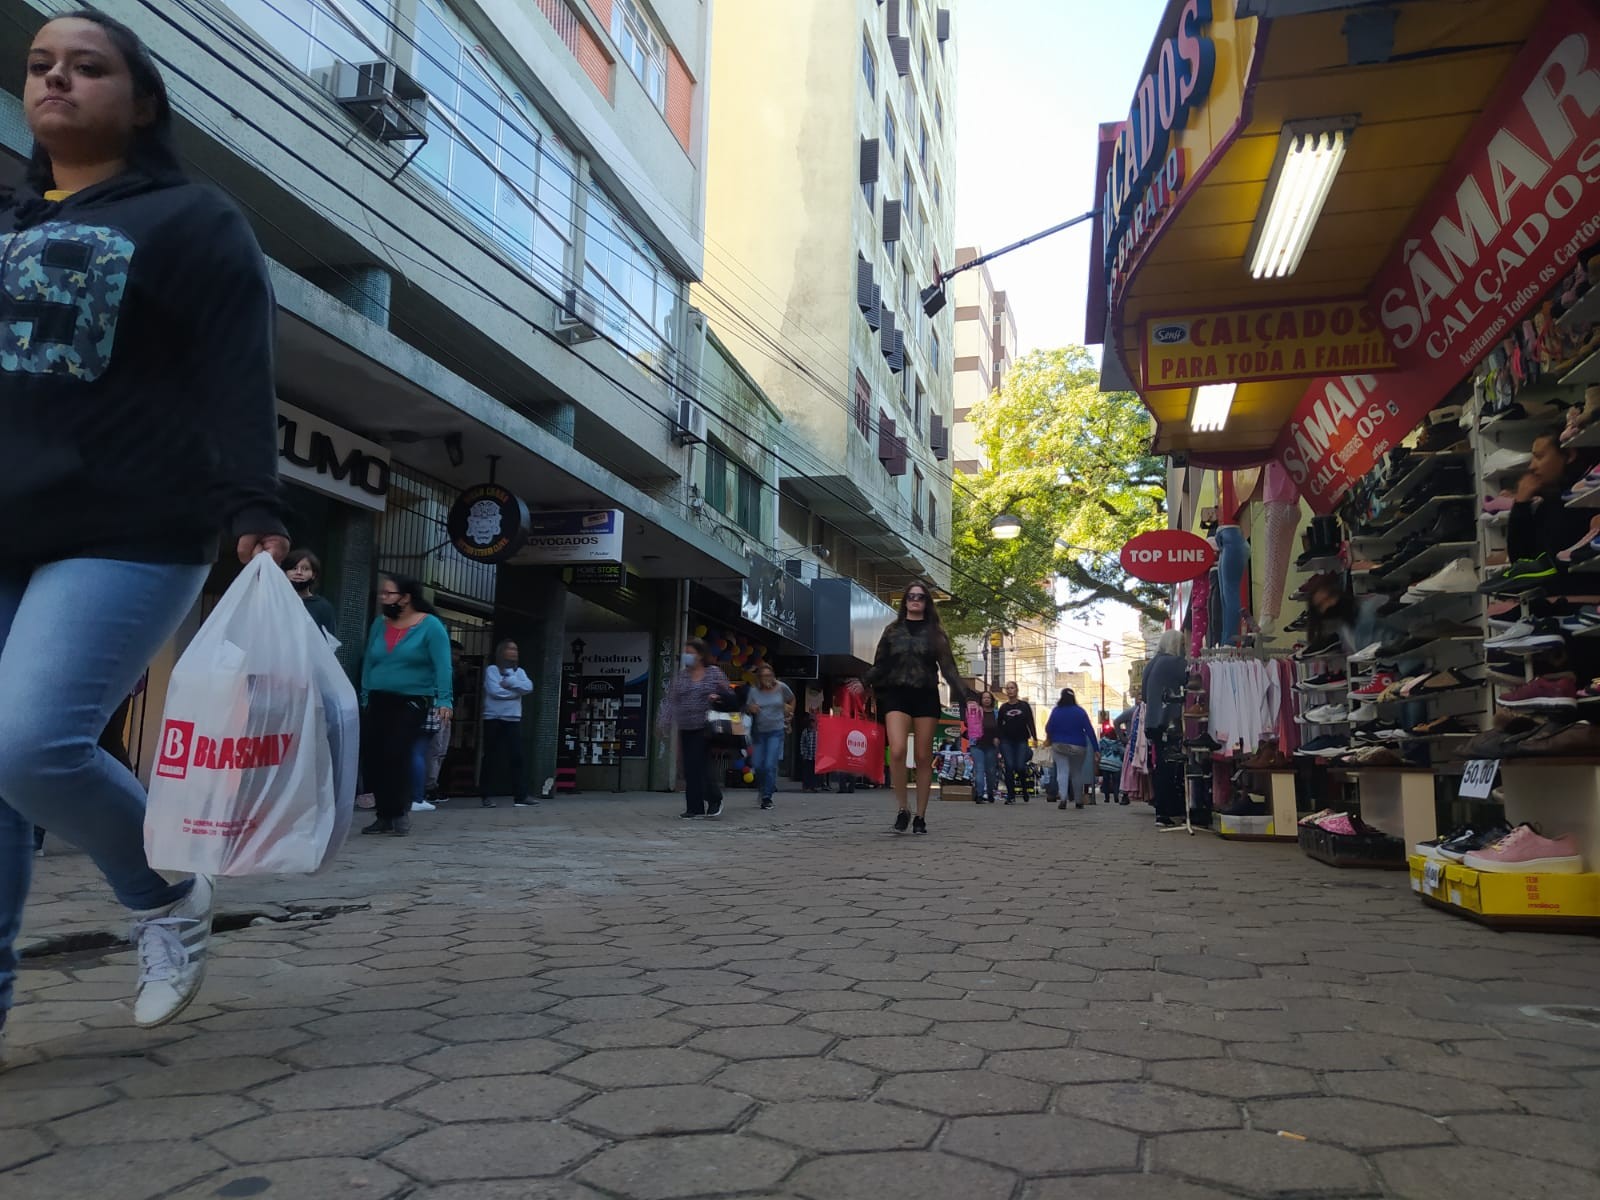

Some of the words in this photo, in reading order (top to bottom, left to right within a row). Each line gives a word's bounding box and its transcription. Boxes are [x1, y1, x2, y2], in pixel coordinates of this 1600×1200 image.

[1459, 315, 1507, 367] Aceitamos
[1502, 279, 1540, 318] Todos
[1538, 263, 1556, 284] os
[1553, 210, 1600, 266] Cartõe
[1190, 307, 1377, 349] CALÇADOS
[1161, 354, 1218, 380] PARA
[1226, 349, 1284, 374] TODA
[1292, 348, 1306, 369] A
[1129, 549, 1162, 563] TOP
[1168, 548, 1205, 563] LINE
[1464, 763, 1493, 788] 50,00
